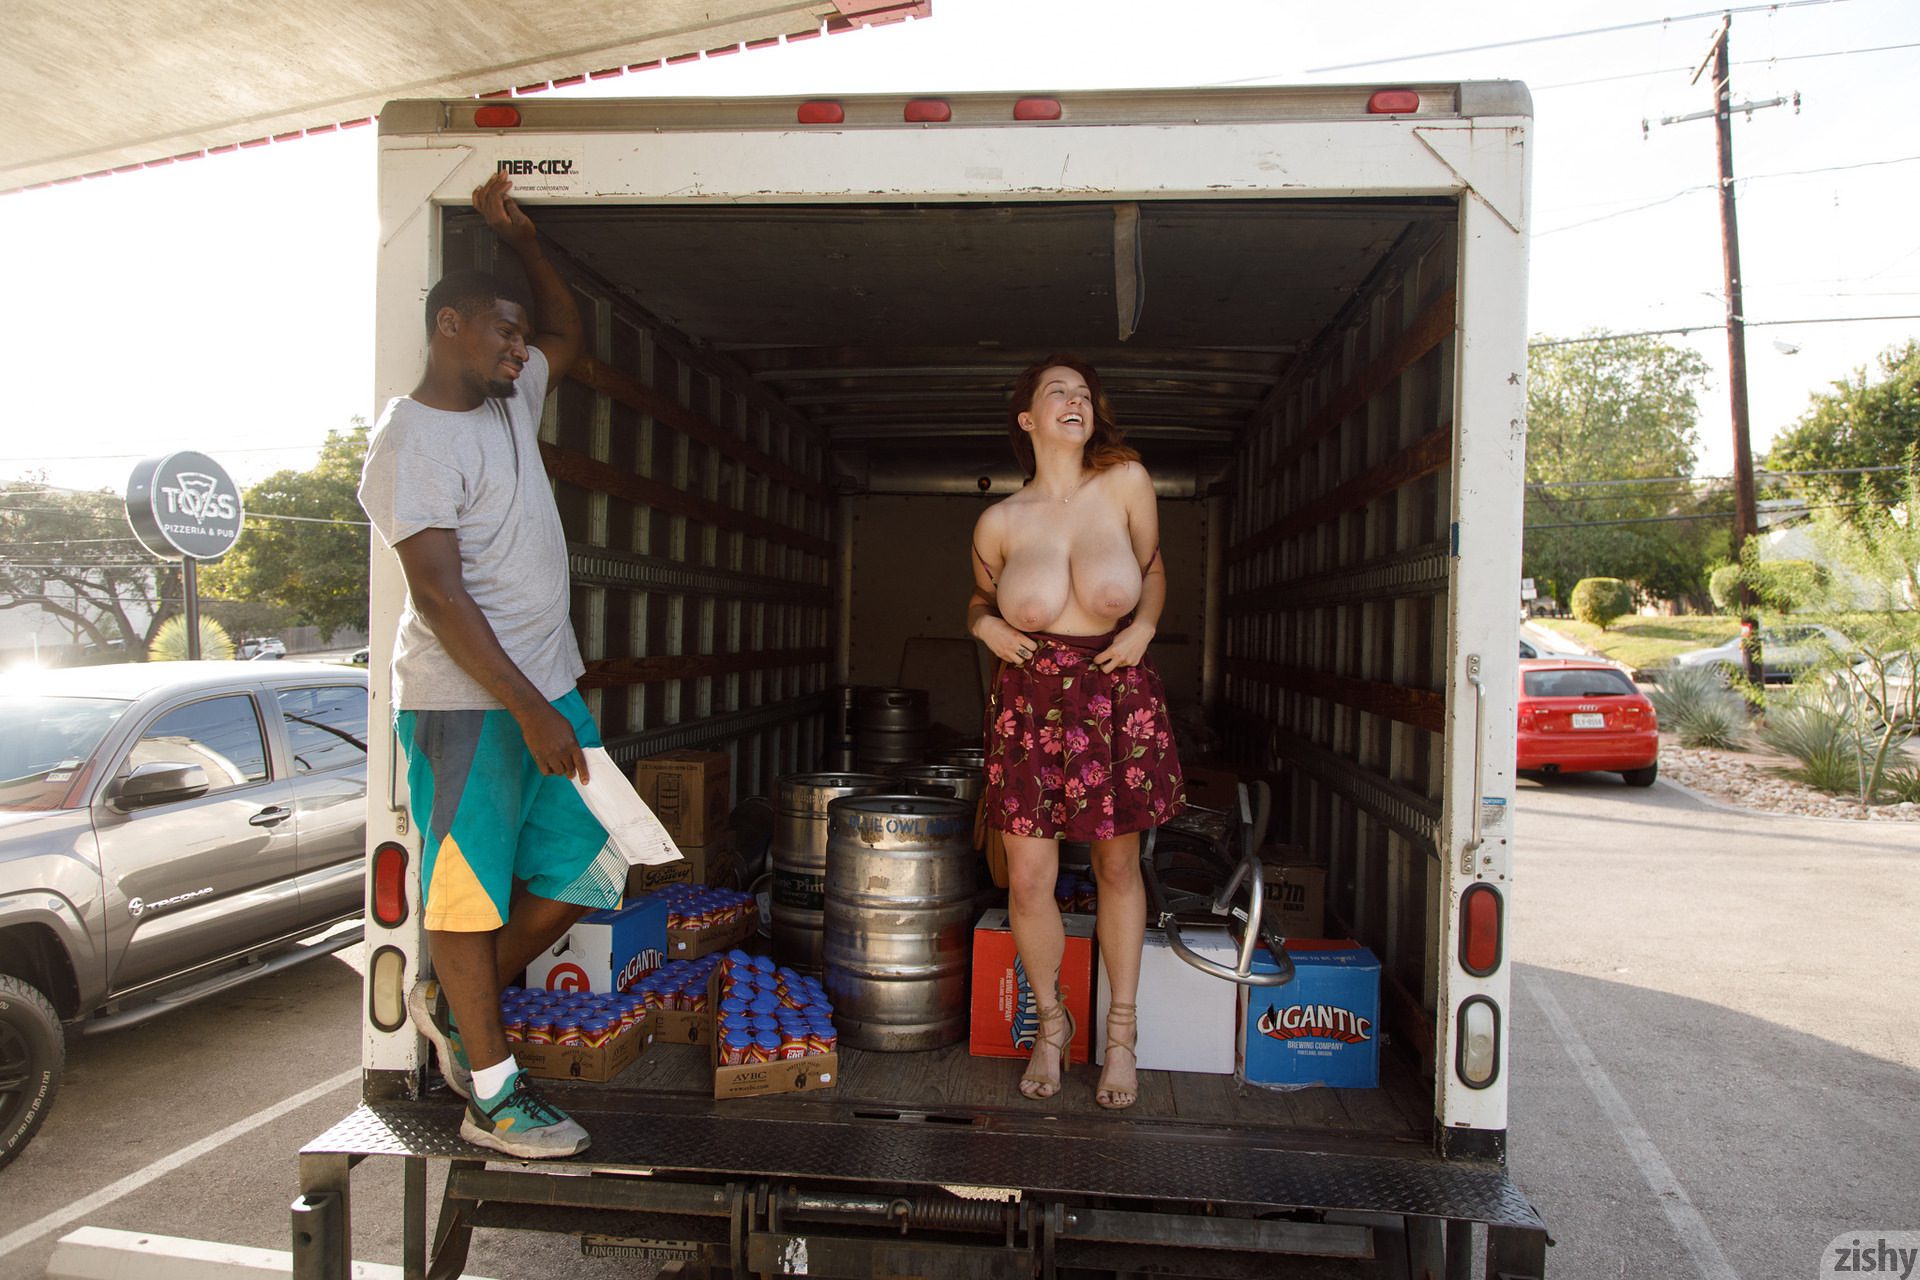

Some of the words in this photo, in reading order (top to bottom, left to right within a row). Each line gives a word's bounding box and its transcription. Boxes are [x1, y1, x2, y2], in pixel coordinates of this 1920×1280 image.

[164, 524, 206, 535] PIZZERIA
[208, 528, 215, 536] &
[217, 530, 235, 538] PUB
[886, 819, 921, 835] OWL
[617, 948, 664, 992] GIGANTIC
[1257, 1004, 1371, 1040] GIGANTIC
[1287, 1040, 1313, 1050] BREWING
[1315, 1041, 1344, 1051] COMPANY
[584, 1245, 644, 1259] LONGHORN
[647, 1248, 699, 1261] RENTALS
